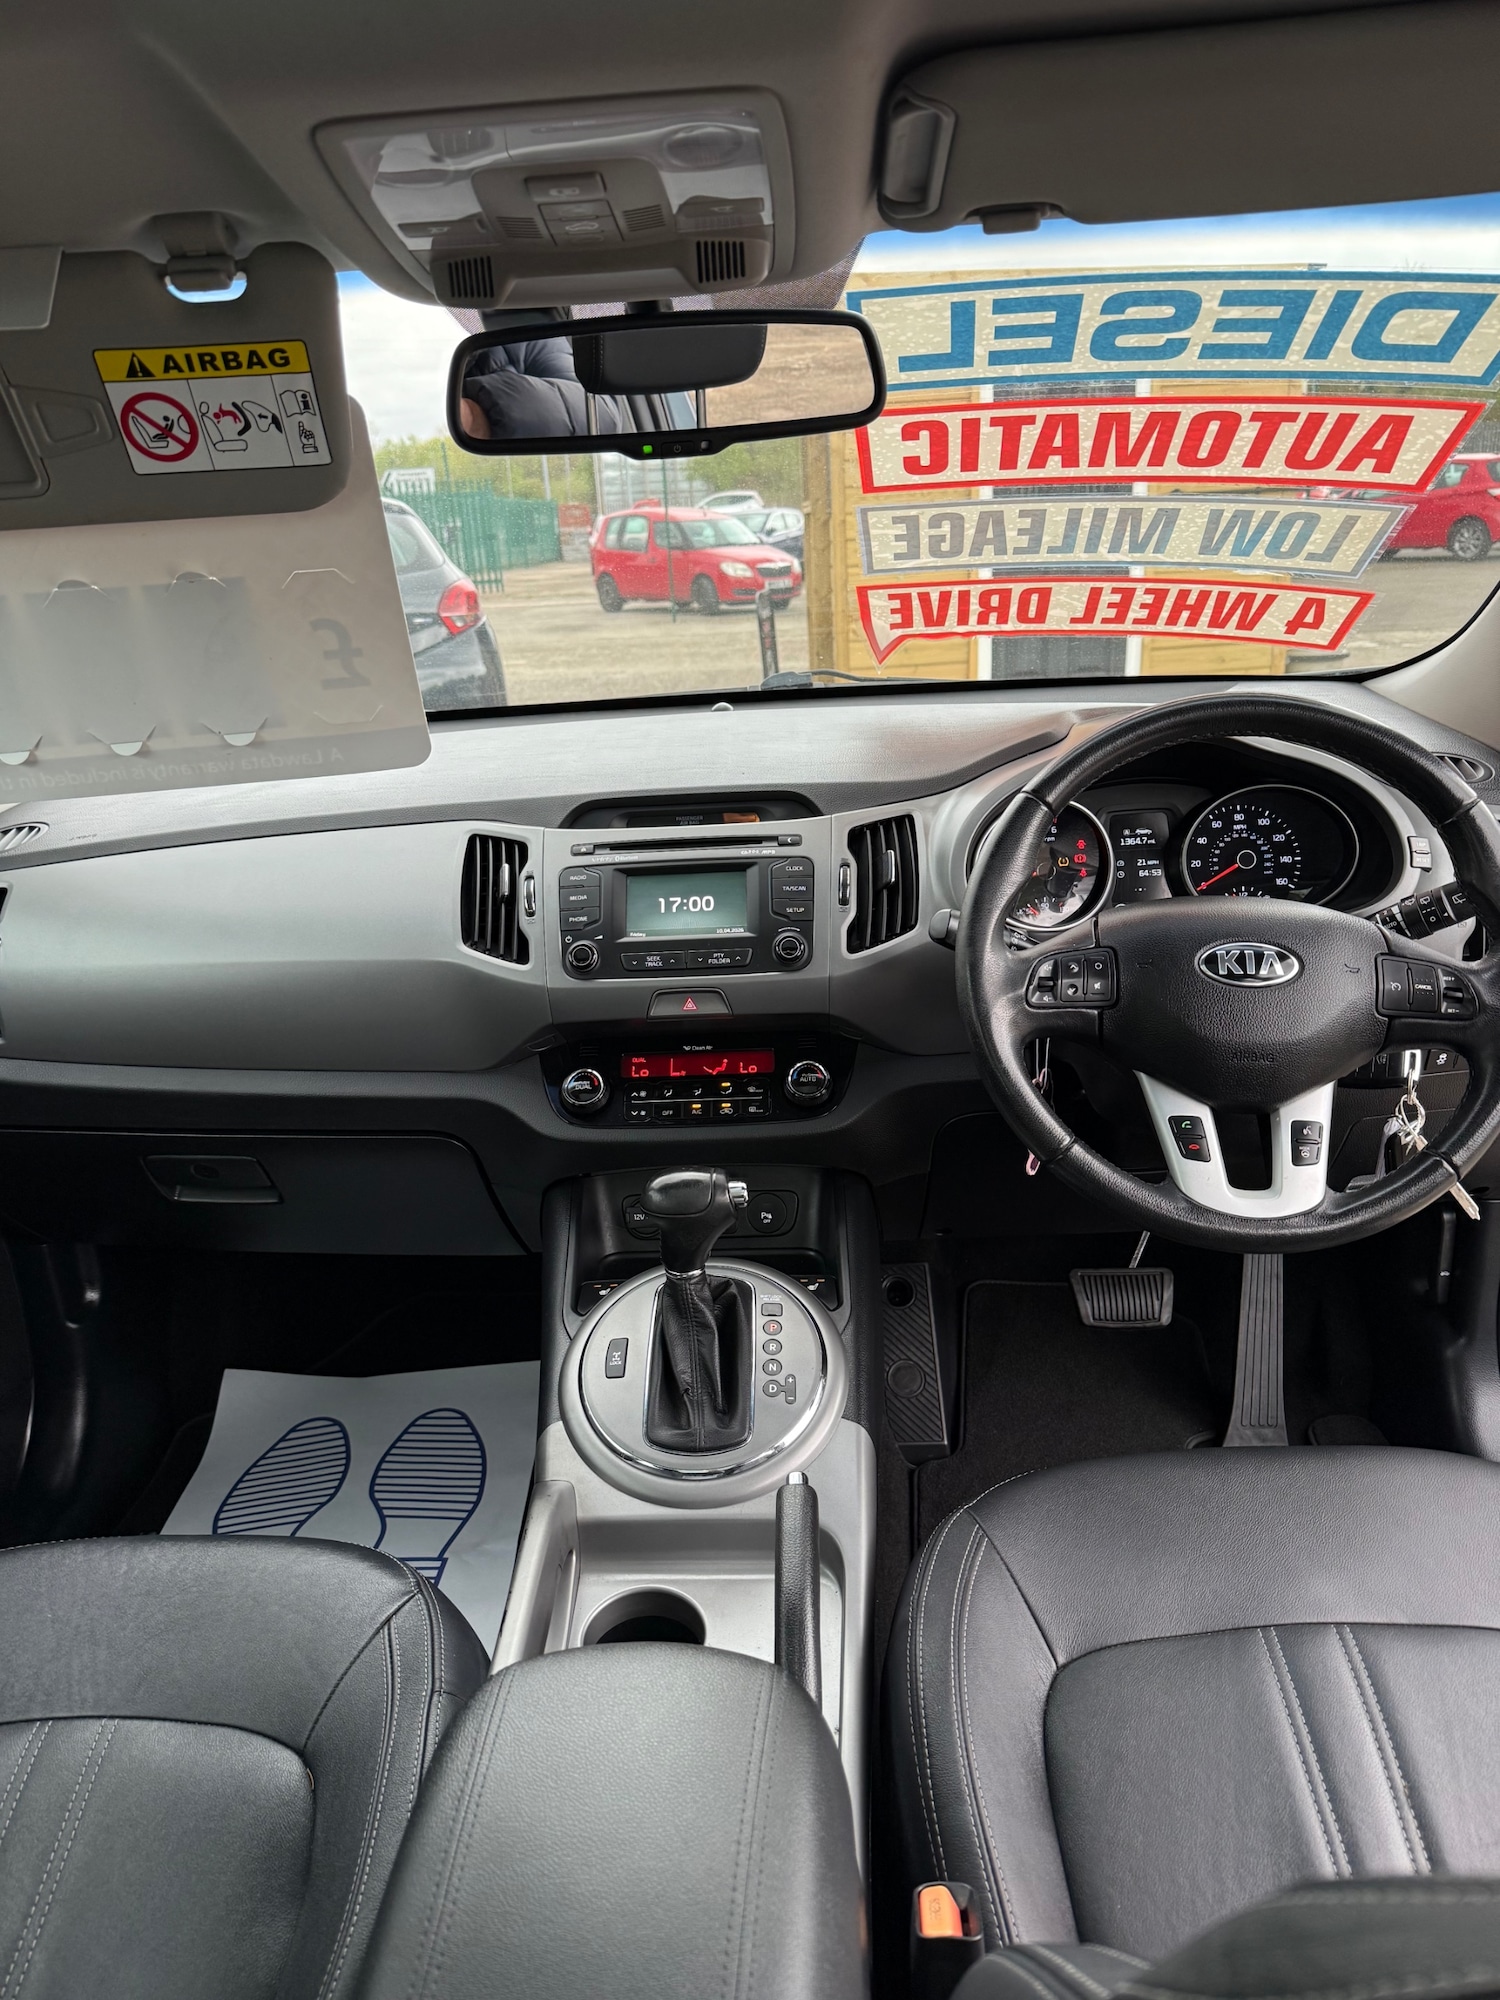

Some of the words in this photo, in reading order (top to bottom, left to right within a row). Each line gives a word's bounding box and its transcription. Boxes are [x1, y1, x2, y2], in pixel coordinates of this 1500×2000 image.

[162, 347, 291, 374] AIRBAG
[1233, 813, 1245, 821] 80
[1211, 820, 1223, 829] 60
[1257, 818, 1271, 826] 100
[1050, 825, 1058, 834] 6
[1120, 836, 1148, 846] 1364.7
[1272, 834, 1286, 842] 120
[1137, 858, 1147, 866] 21
[1279, 855, 1293, 863] 140
[1190, 860, 1202, 868] 20
[1138, 868, 1162, 877] 64:53
[1275, 877, 1289, 886] 160
[658, 895, 715, 914] 17:00
[1216, 950, 1285, 976] KIA
[1414, 983, 1434, 991] CANCEL
[1230, 1051, 1275, 1064] AIRBAG
[799, 1075, 817, 1083] AUTO
[574, 1082, 593, 1090] DUAL
[769, 1323, 778, 1332] P
[769, 1343, 777, 1351] R
[769, 1363, 777, 1371] N
[769, 1384, 777, 1393] D
